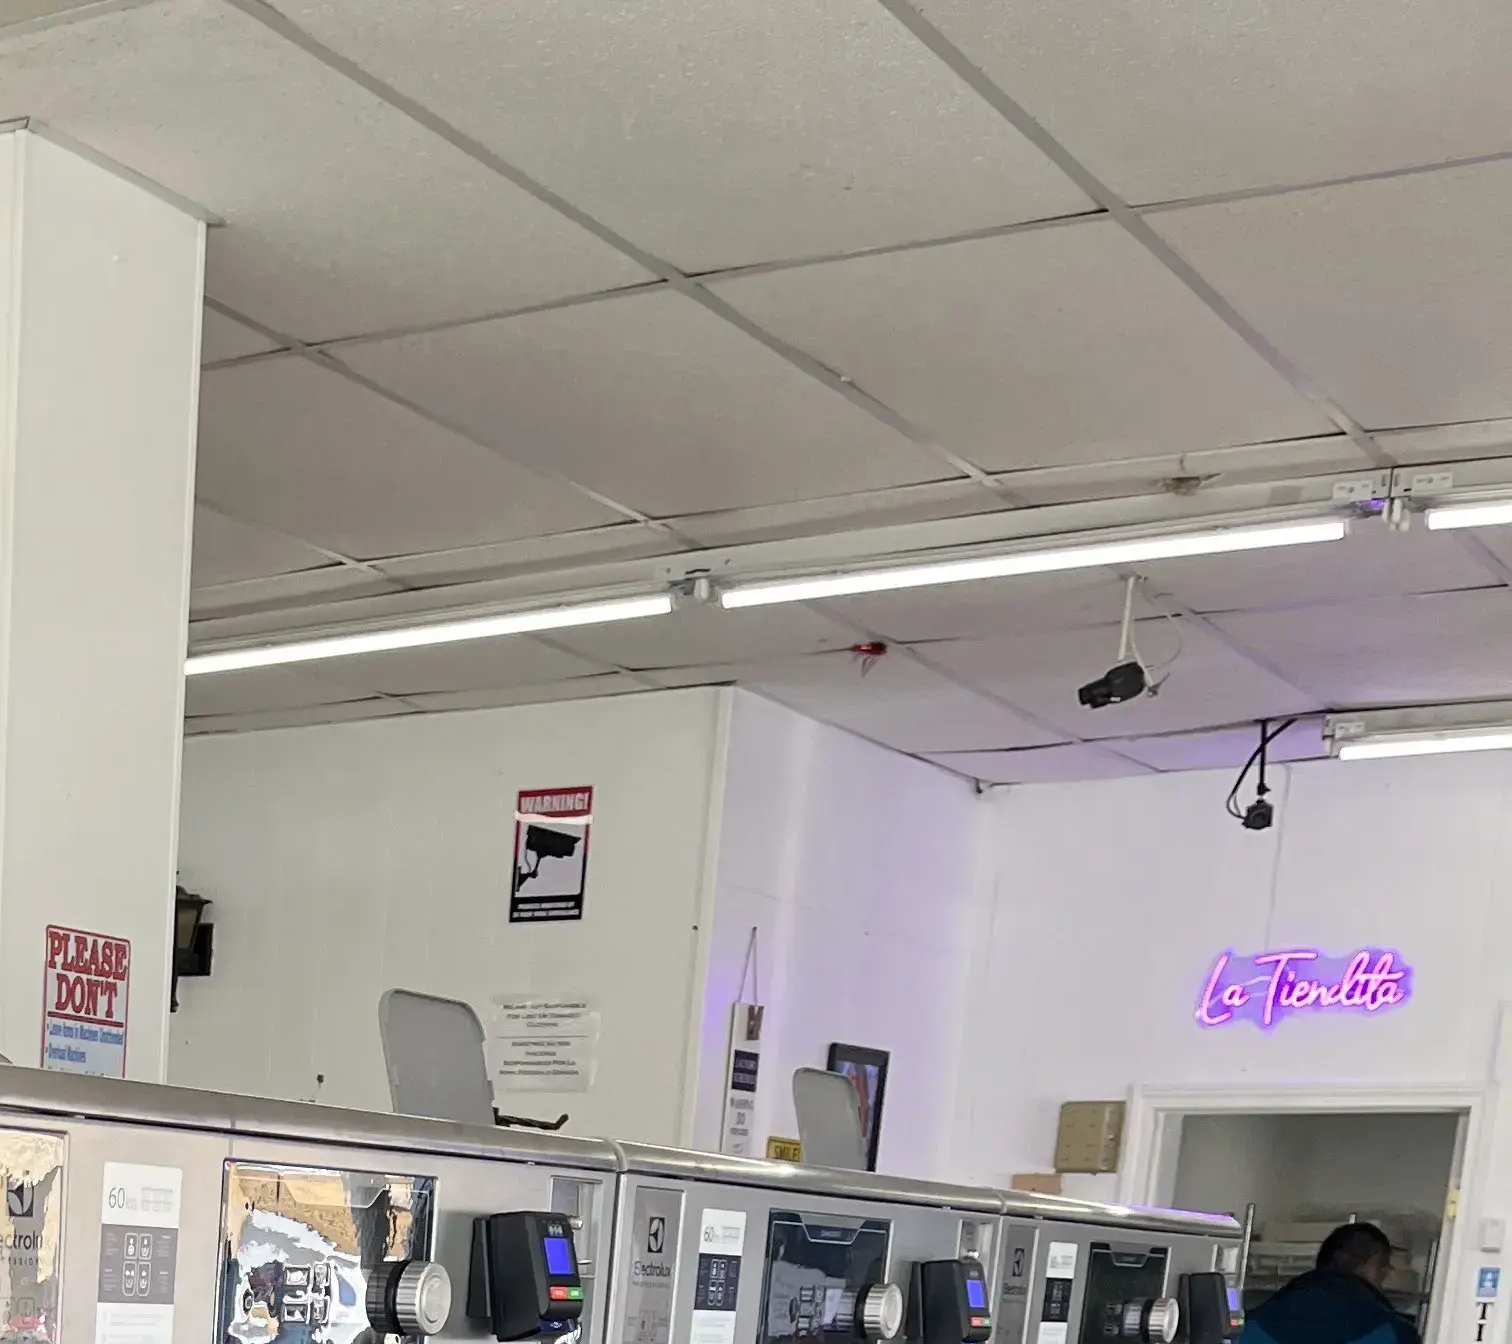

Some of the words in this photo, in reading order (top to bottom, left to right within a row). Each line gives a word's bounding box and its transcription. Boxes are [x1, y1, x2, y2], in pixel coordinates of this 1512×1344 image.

[48, 930, 127, 981] PLEASE
[55, 973, 118, 1019] DON'T
[1195, 953, 1250, 1026] La
[1255, 950, 1406, 1026] Tiendita
